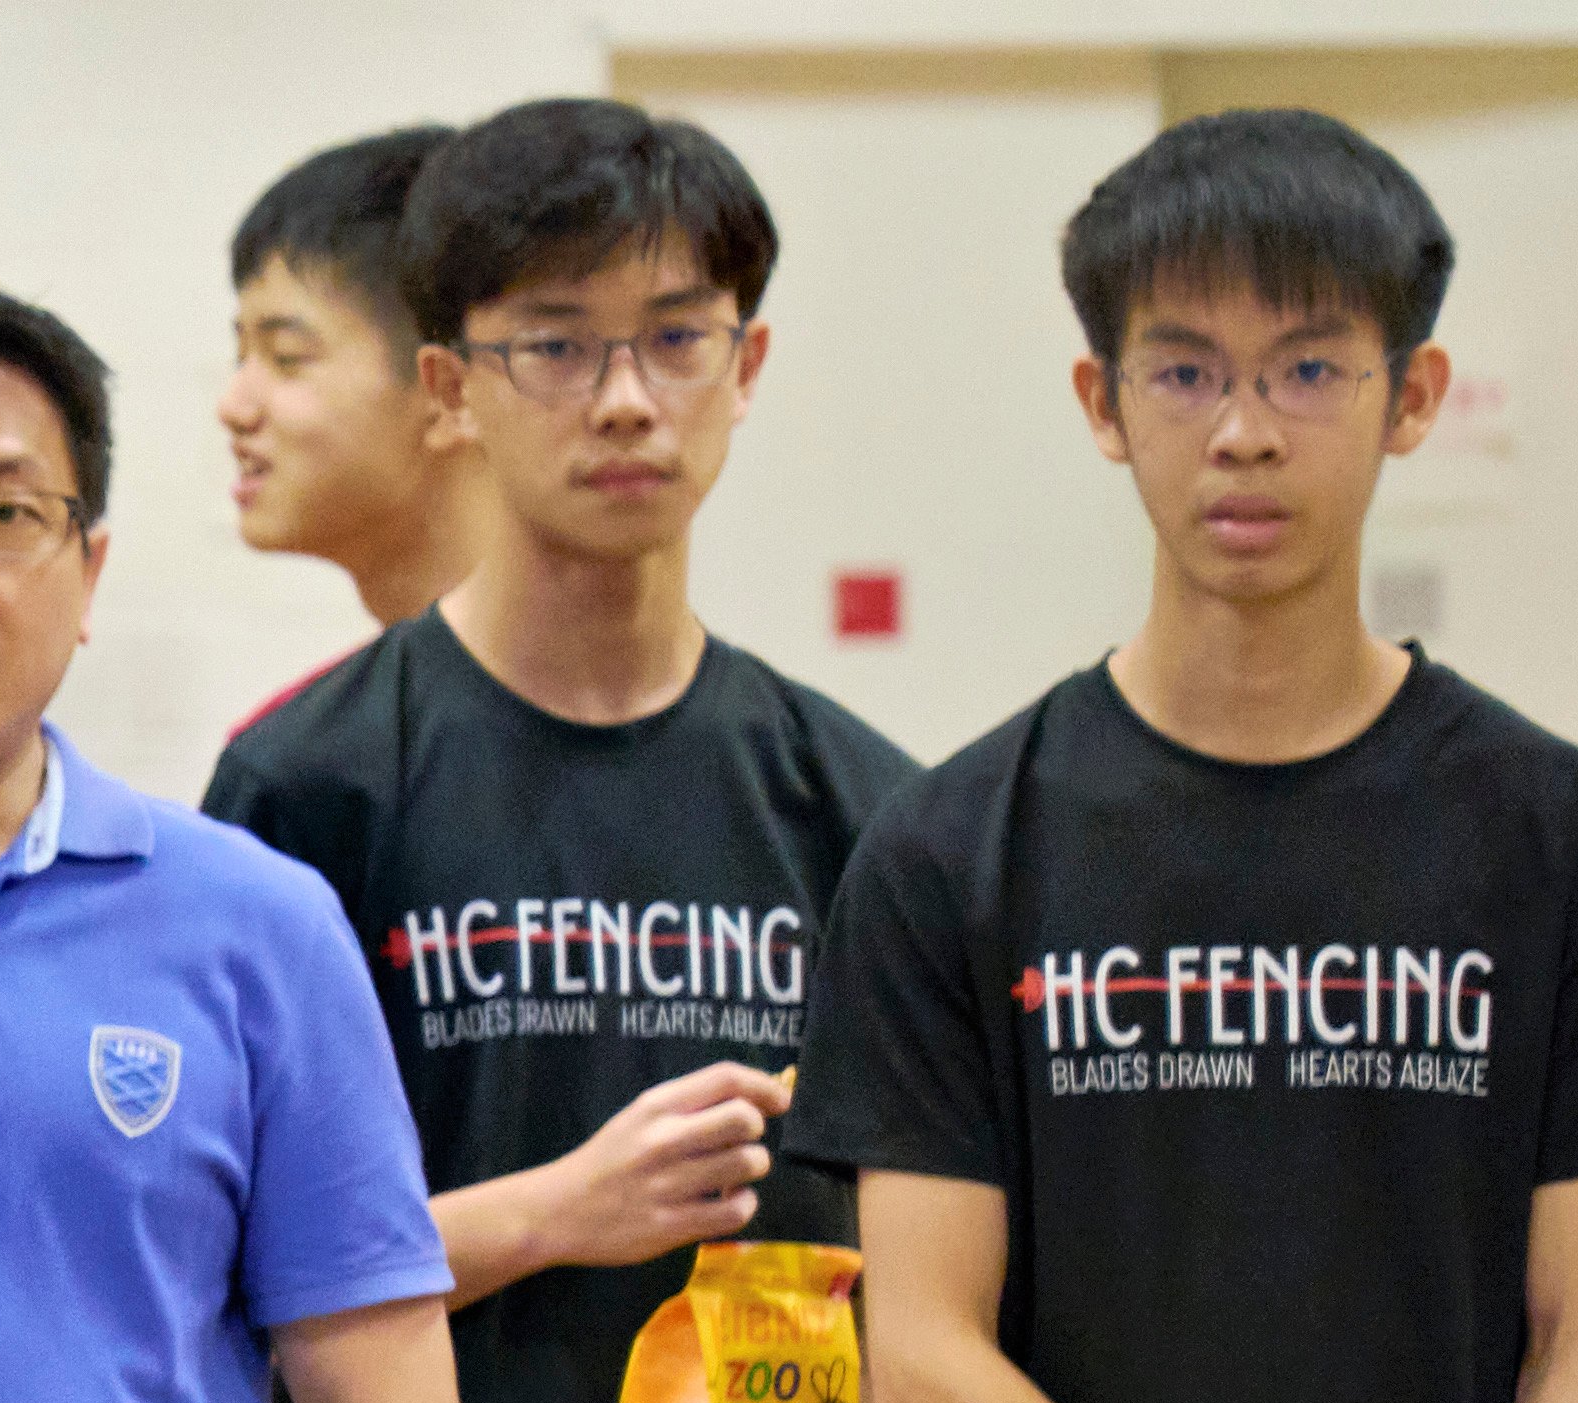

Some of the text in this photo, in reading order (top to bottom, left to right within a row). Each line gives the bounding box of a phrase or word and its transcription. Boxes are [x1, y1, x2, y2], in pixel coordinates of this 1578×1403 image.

[405, 897, 804, 1007] HC FENCING
[1043, 943, 1495, 1054] HC FENCING
[421, 1000, 512, 1052] BLADES
[621, 1000, 714, 1042] HEARTS
[718, 1005, 804, 1049] ABLAZE
[1049, 1049, 1490, 1099] BLADES DRAWN HEARTS ABLAZE
[724, 1358, 802, 1403] ZOO
